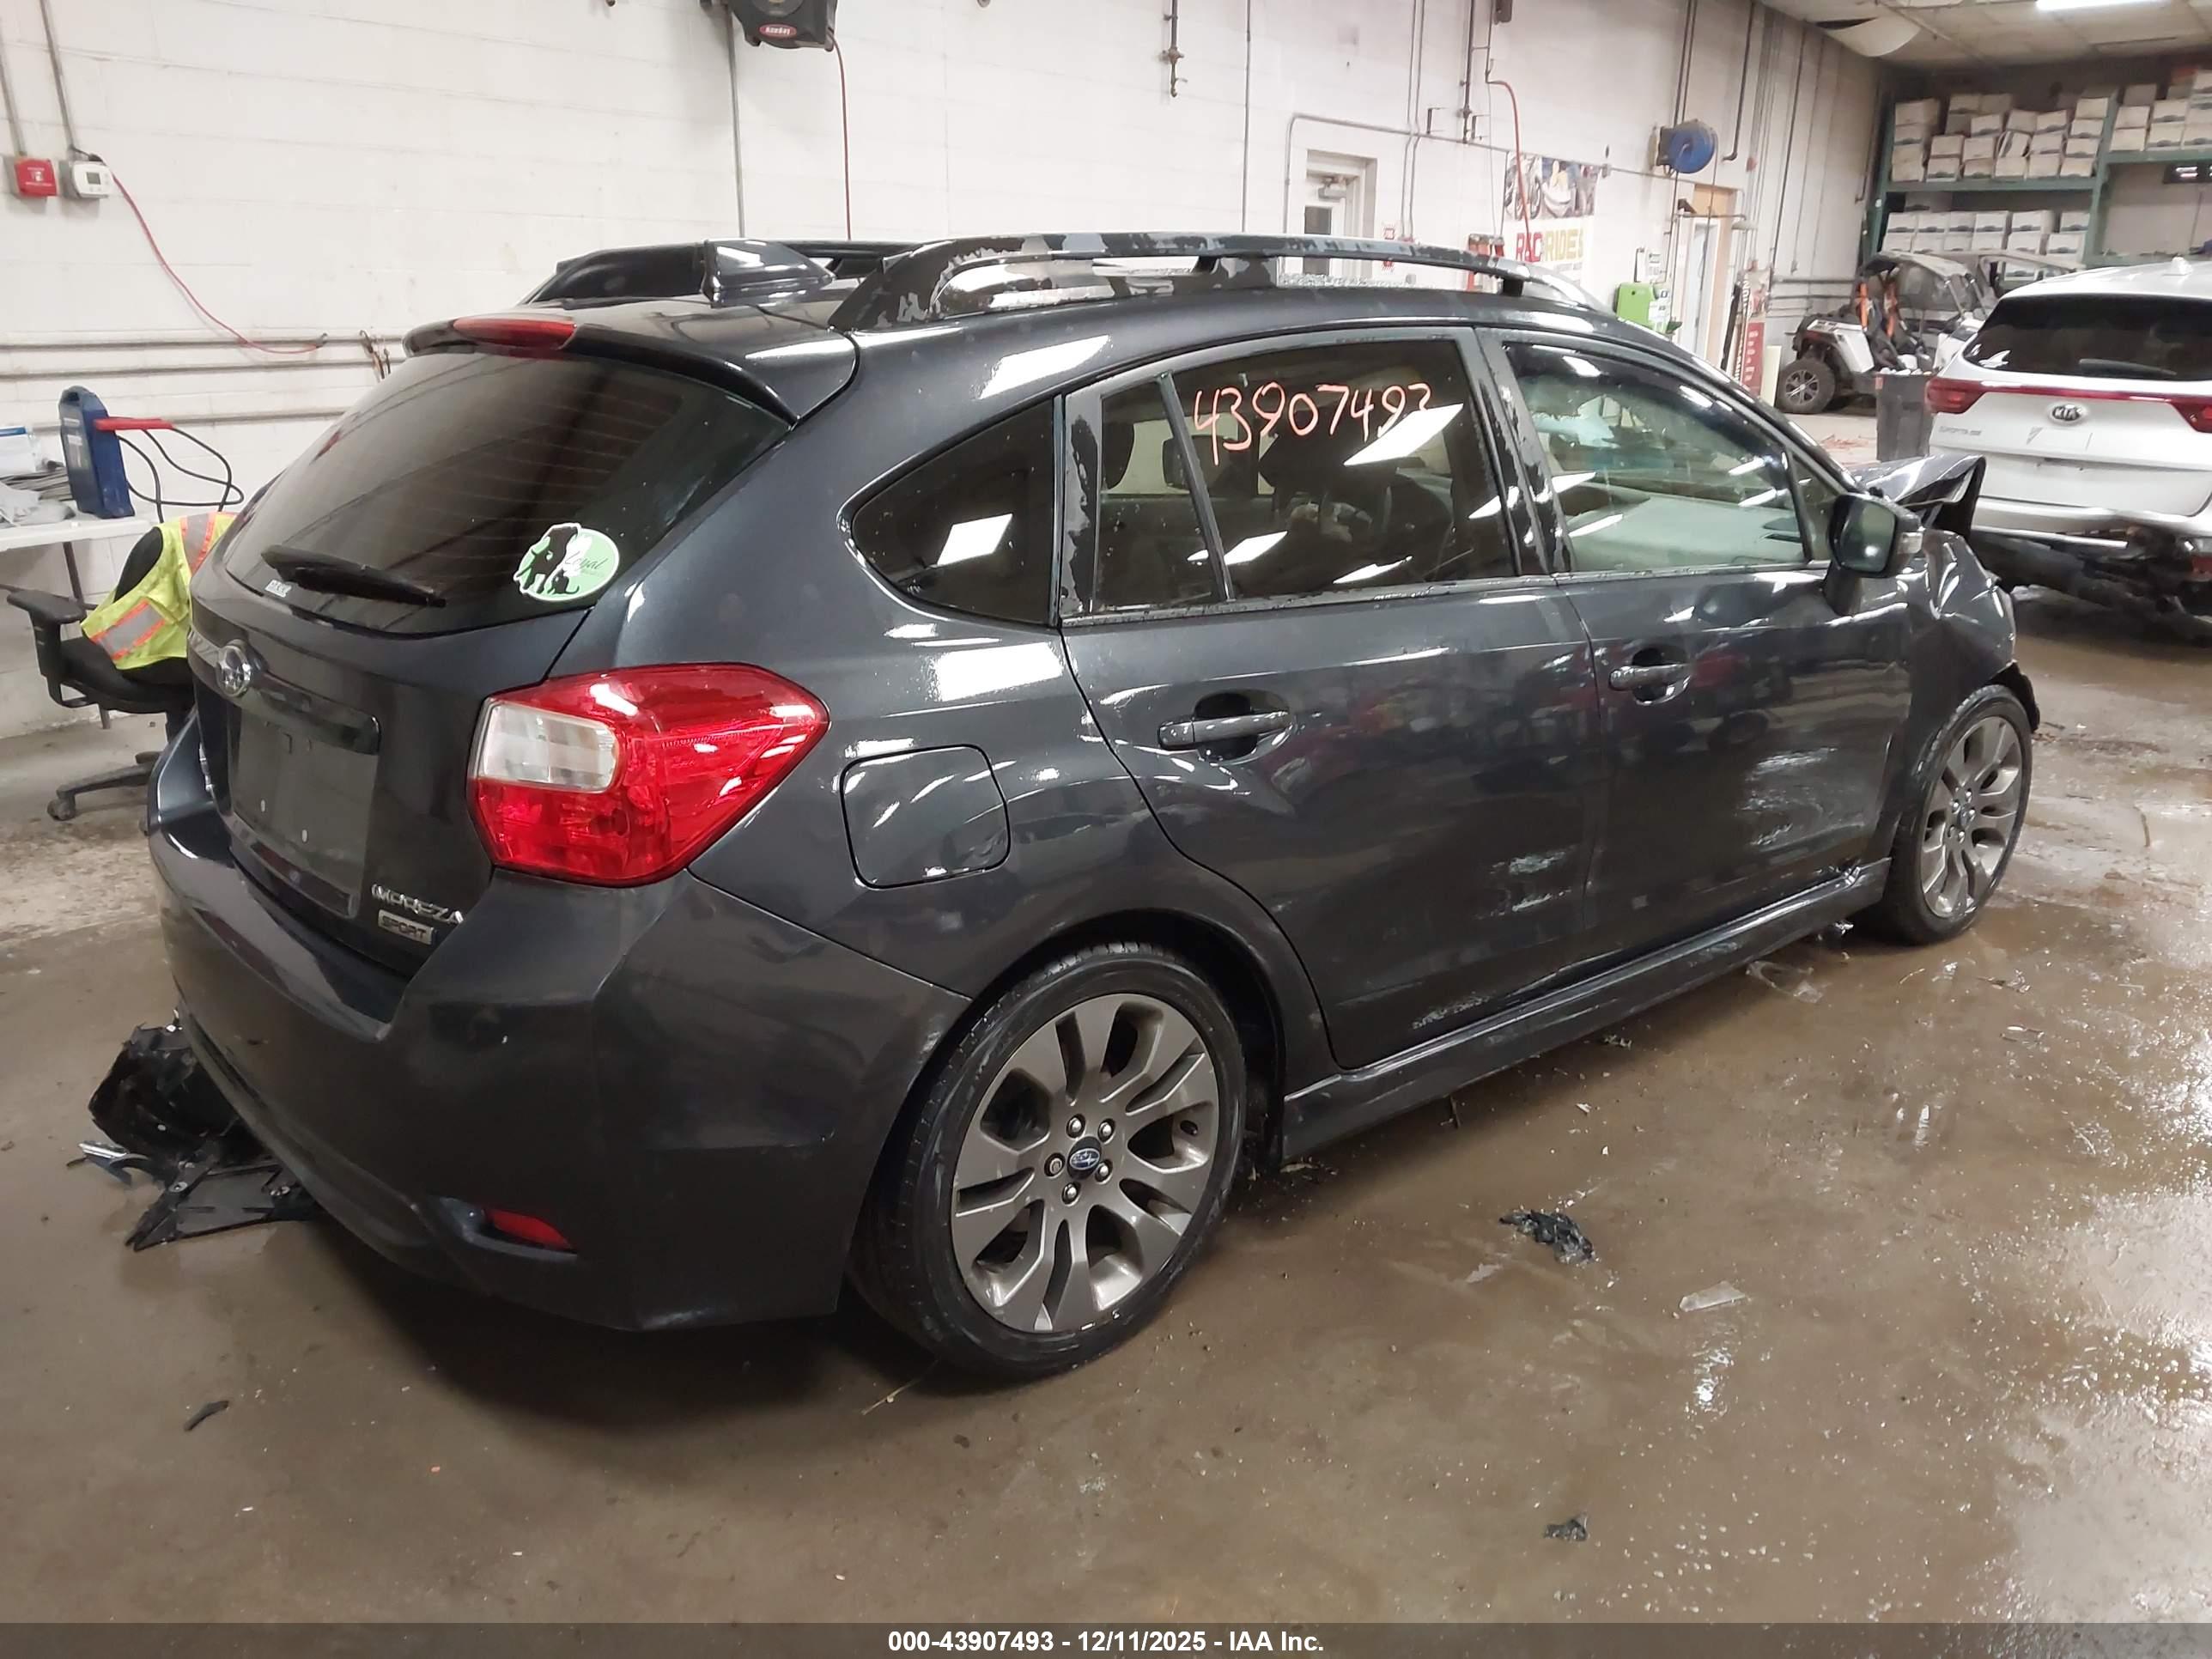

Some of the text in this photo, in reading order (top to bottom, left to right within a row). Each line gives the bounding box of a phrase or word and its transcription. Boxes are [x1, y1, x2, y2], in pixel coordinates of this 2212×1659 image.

[1193, 381, 1432, 466] 43907493
[2054, 407, 2077, 420] KIA
[371, 884, 464, 925] IMPREZA
[381, 915, 428, 939] SPORT
